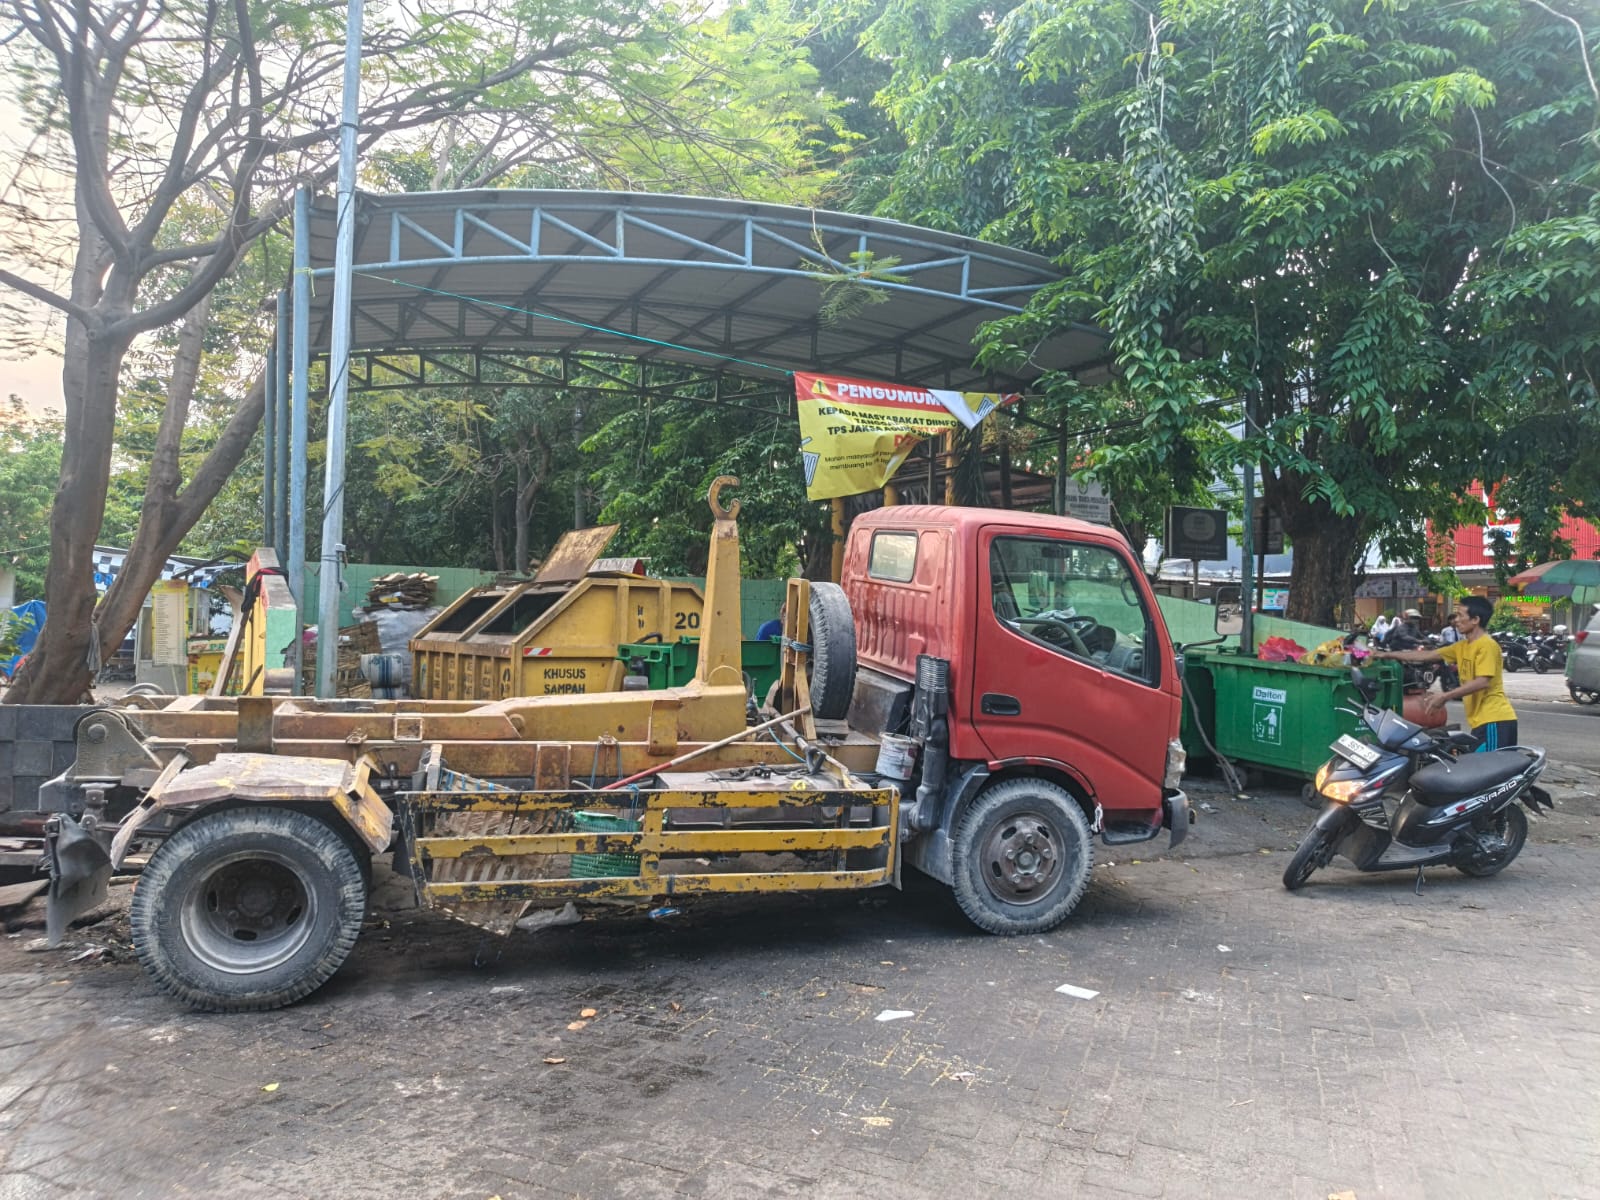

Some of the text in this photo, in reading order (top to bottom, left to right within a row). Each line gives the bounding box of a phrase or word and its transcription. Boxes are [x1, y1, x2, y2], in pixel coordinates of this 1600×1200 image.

[837, 383, 941, 406] PENGUMUM
[818, 407, 858, 417] KEPADA
[926, 418, 958, 427] DIINFO
[827, 425, 847, 435] TPS
[674, 612, 700, 629] 20
[544, 668, 586, 679] KHUSUS
[544, 683, 585, 694] SAMPAH
[1477, 780, 1517, 803] VARIO
